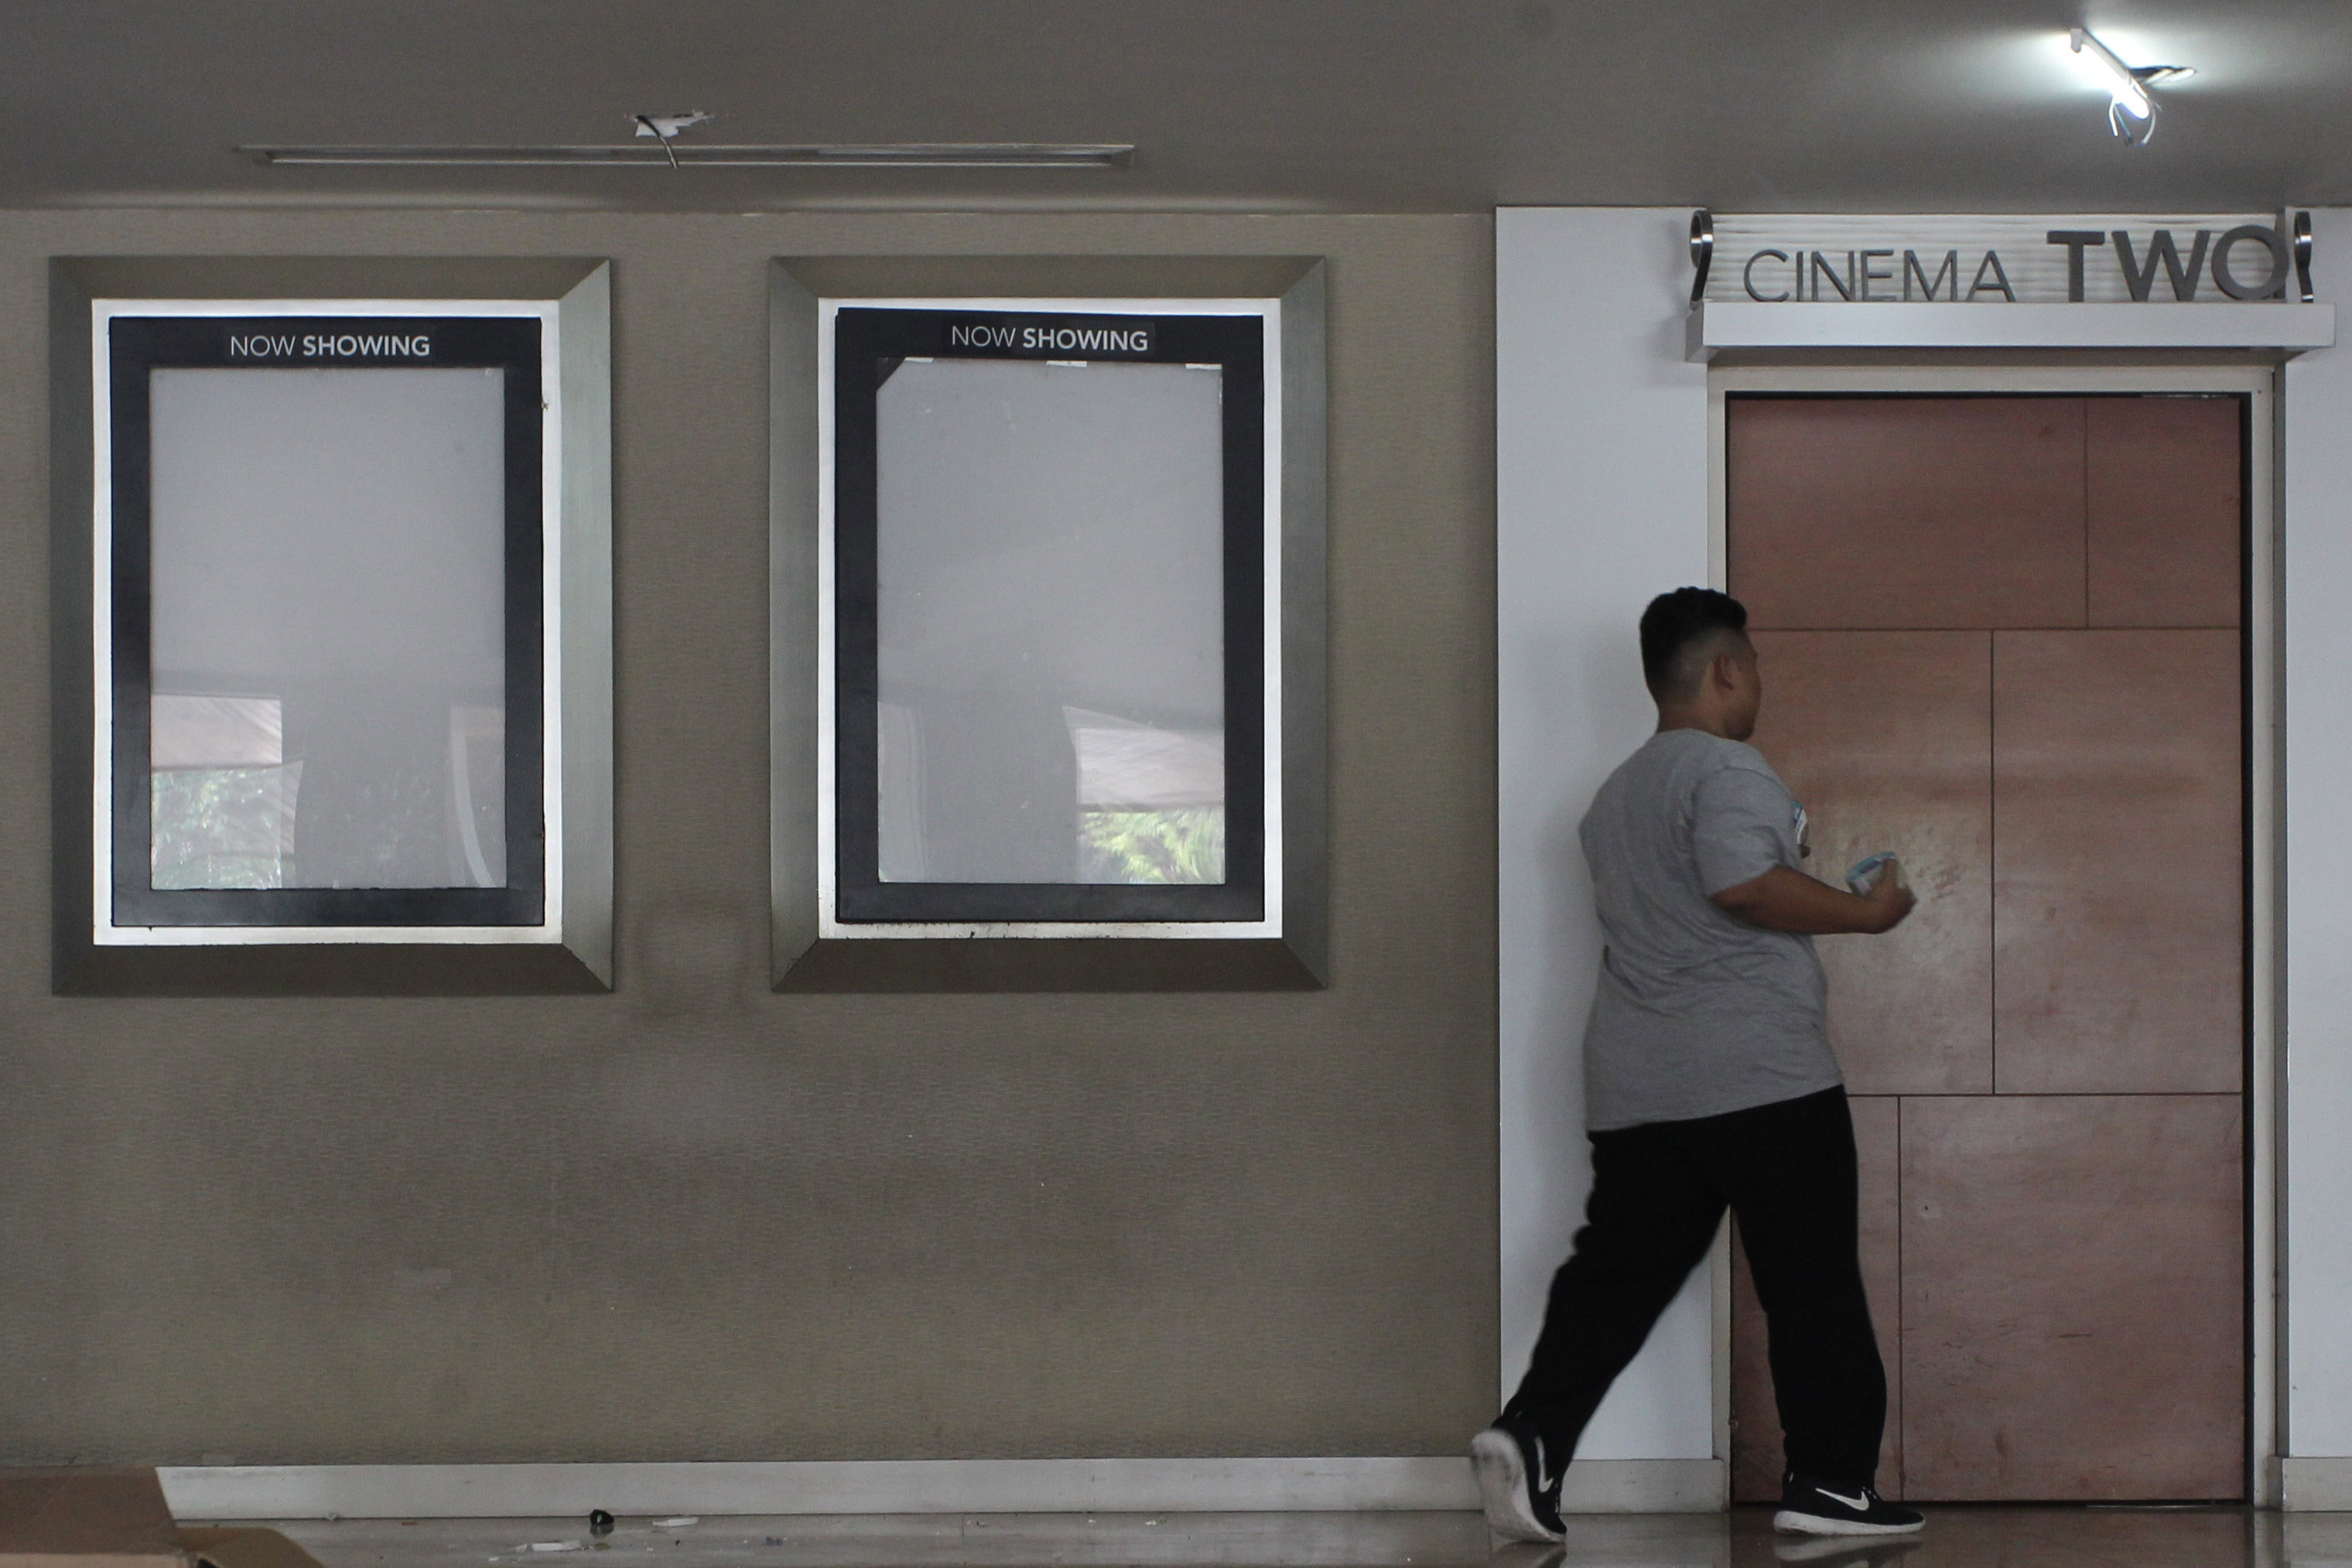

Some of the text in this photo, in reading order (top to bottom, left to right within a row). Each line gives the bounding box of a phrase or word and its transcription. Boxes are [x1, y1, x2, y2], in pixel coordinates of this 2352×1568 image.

[1742, 224, 2289, 302] CINEMA TWO
[231, 335, 430, 357] NOW SHOWING
[952, 326, 1148, 351] NOW SHOWING
